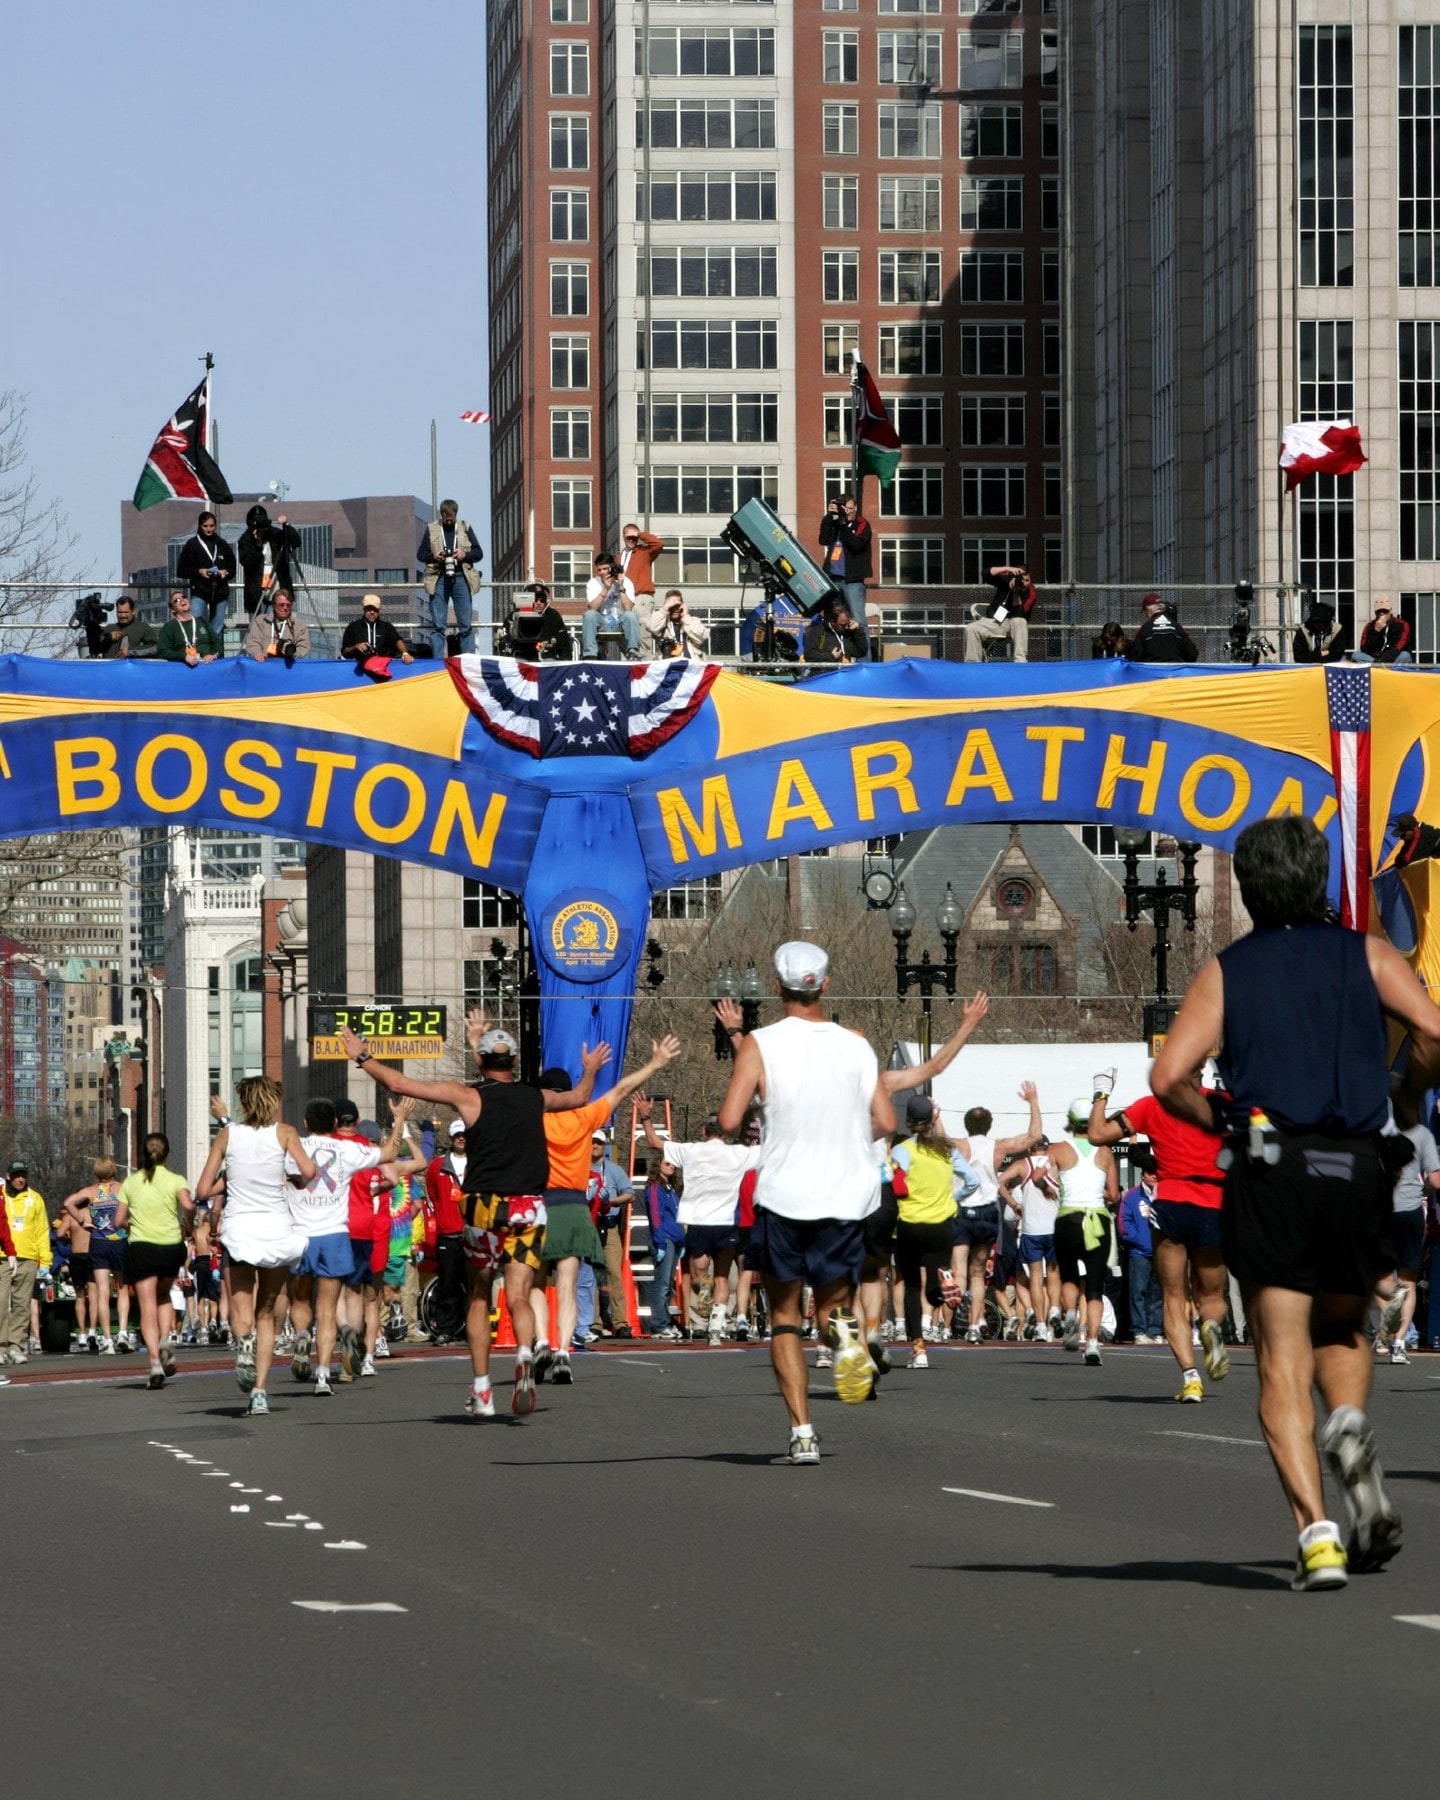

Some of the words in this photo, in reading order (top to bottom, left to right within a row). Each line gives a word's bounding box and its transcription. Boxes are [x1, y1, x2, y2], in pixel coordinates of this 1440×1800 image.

[54, 733, 508, 870] BOSTON
[554, 918, 564, 945] BOSTON
[562, 903, 593, 919] ATHLETIC
[594, 905, 616, 946] ASSOCIATION
[334, 1011, 440, 1035] 3:58:22
[316, 1040, 343, 1055] B.A.A.
[386, 1040, 441, 1054] MARATHON
[300, 1196, 341, 1207] AUTISM
